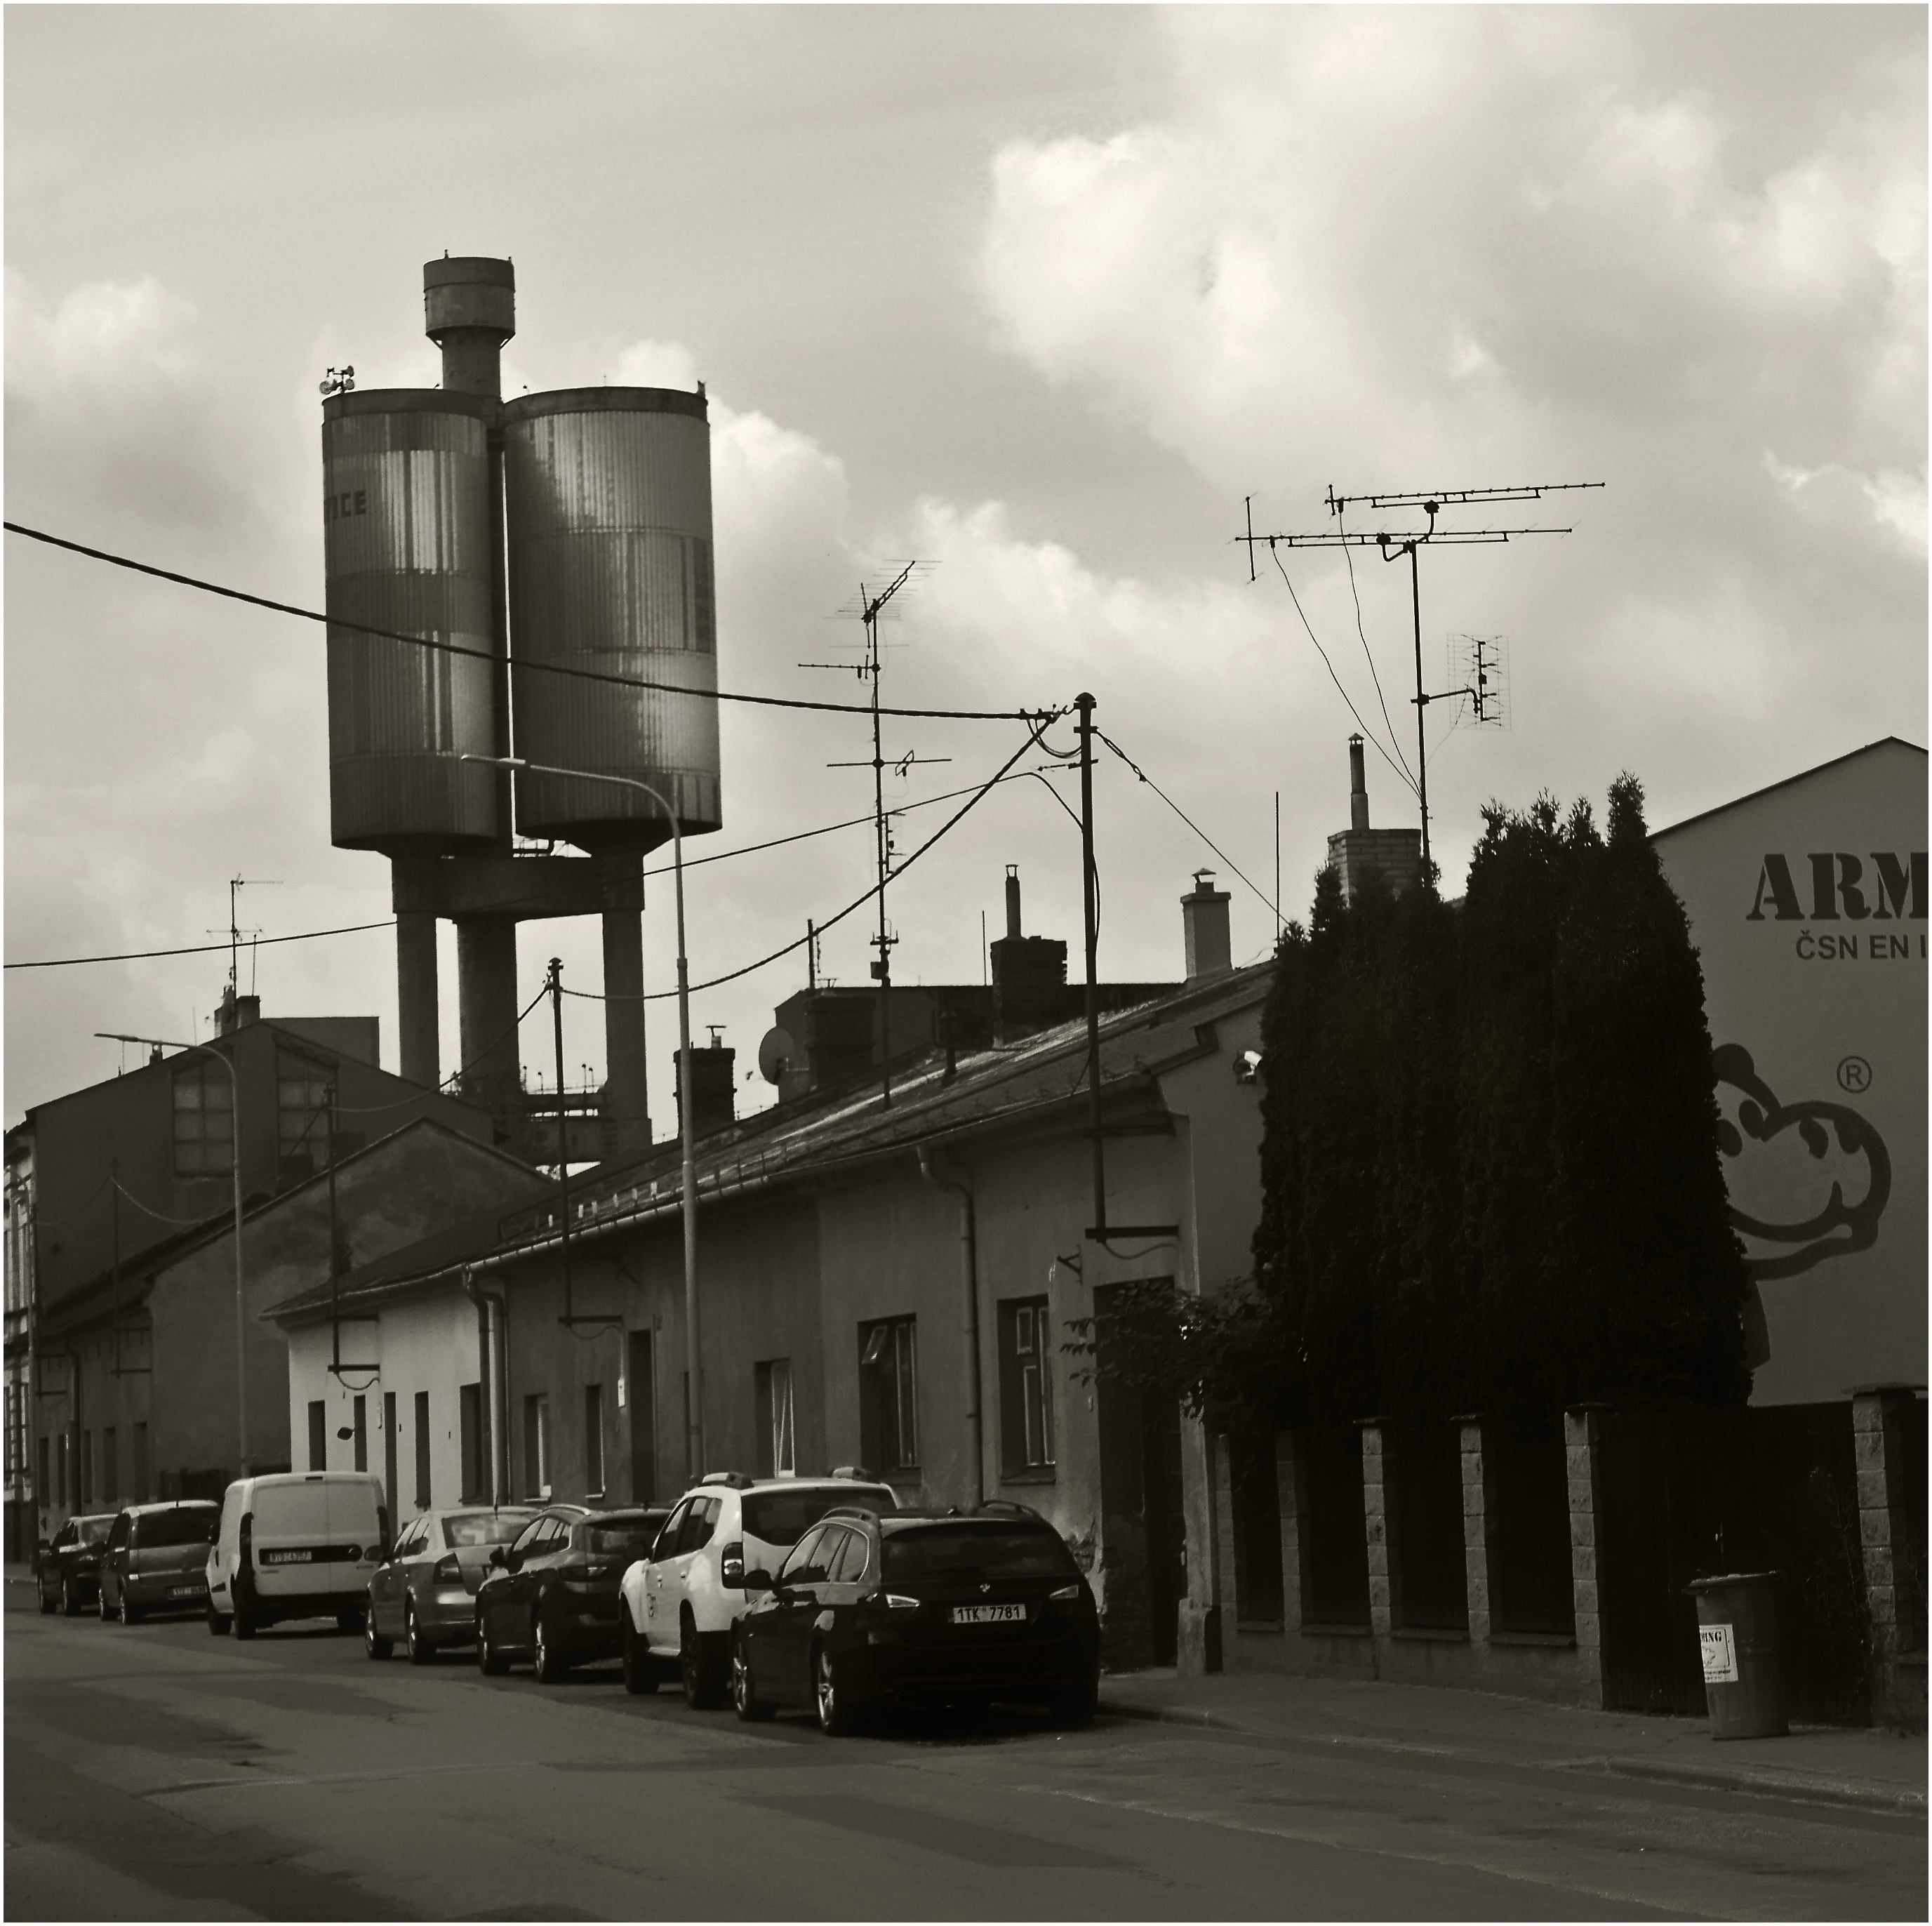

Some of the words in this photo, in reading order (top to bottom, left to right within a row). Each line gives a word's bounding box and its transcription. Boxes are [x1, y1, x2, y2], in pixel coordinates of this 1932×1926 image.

[1745, 852, 1928, 920] ARM
[1795, 929, 1859, 960] ČSN
[1870, 934, 1910, 959] EN
[957, 1608, 980, 1621] 1TK
[990, 1605, 1020, 1620] 7781
